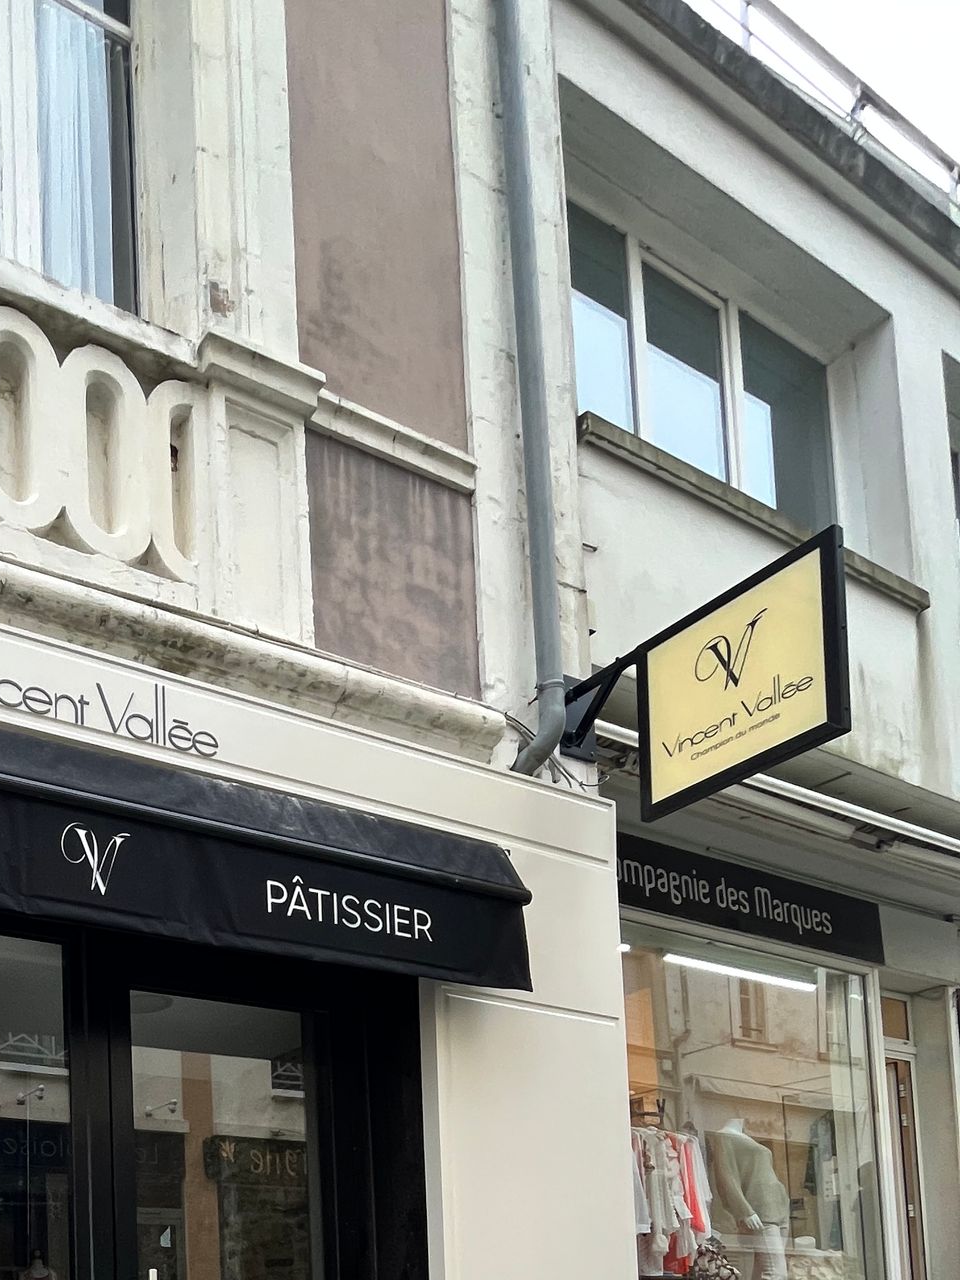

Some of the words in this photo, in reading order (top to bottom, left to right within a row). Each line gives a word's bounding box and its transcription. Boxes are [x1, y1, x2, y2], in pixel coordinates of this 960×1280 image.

[661, 711, 738, 758] Vincent
[690, 735, 734, 761] Champion
[748, 712, 781, 733] monde
[265, 875, 434, 943] PÂTISSIER
[716, 877, 750, 914] des
[754, 886, 833, 935] Marques
